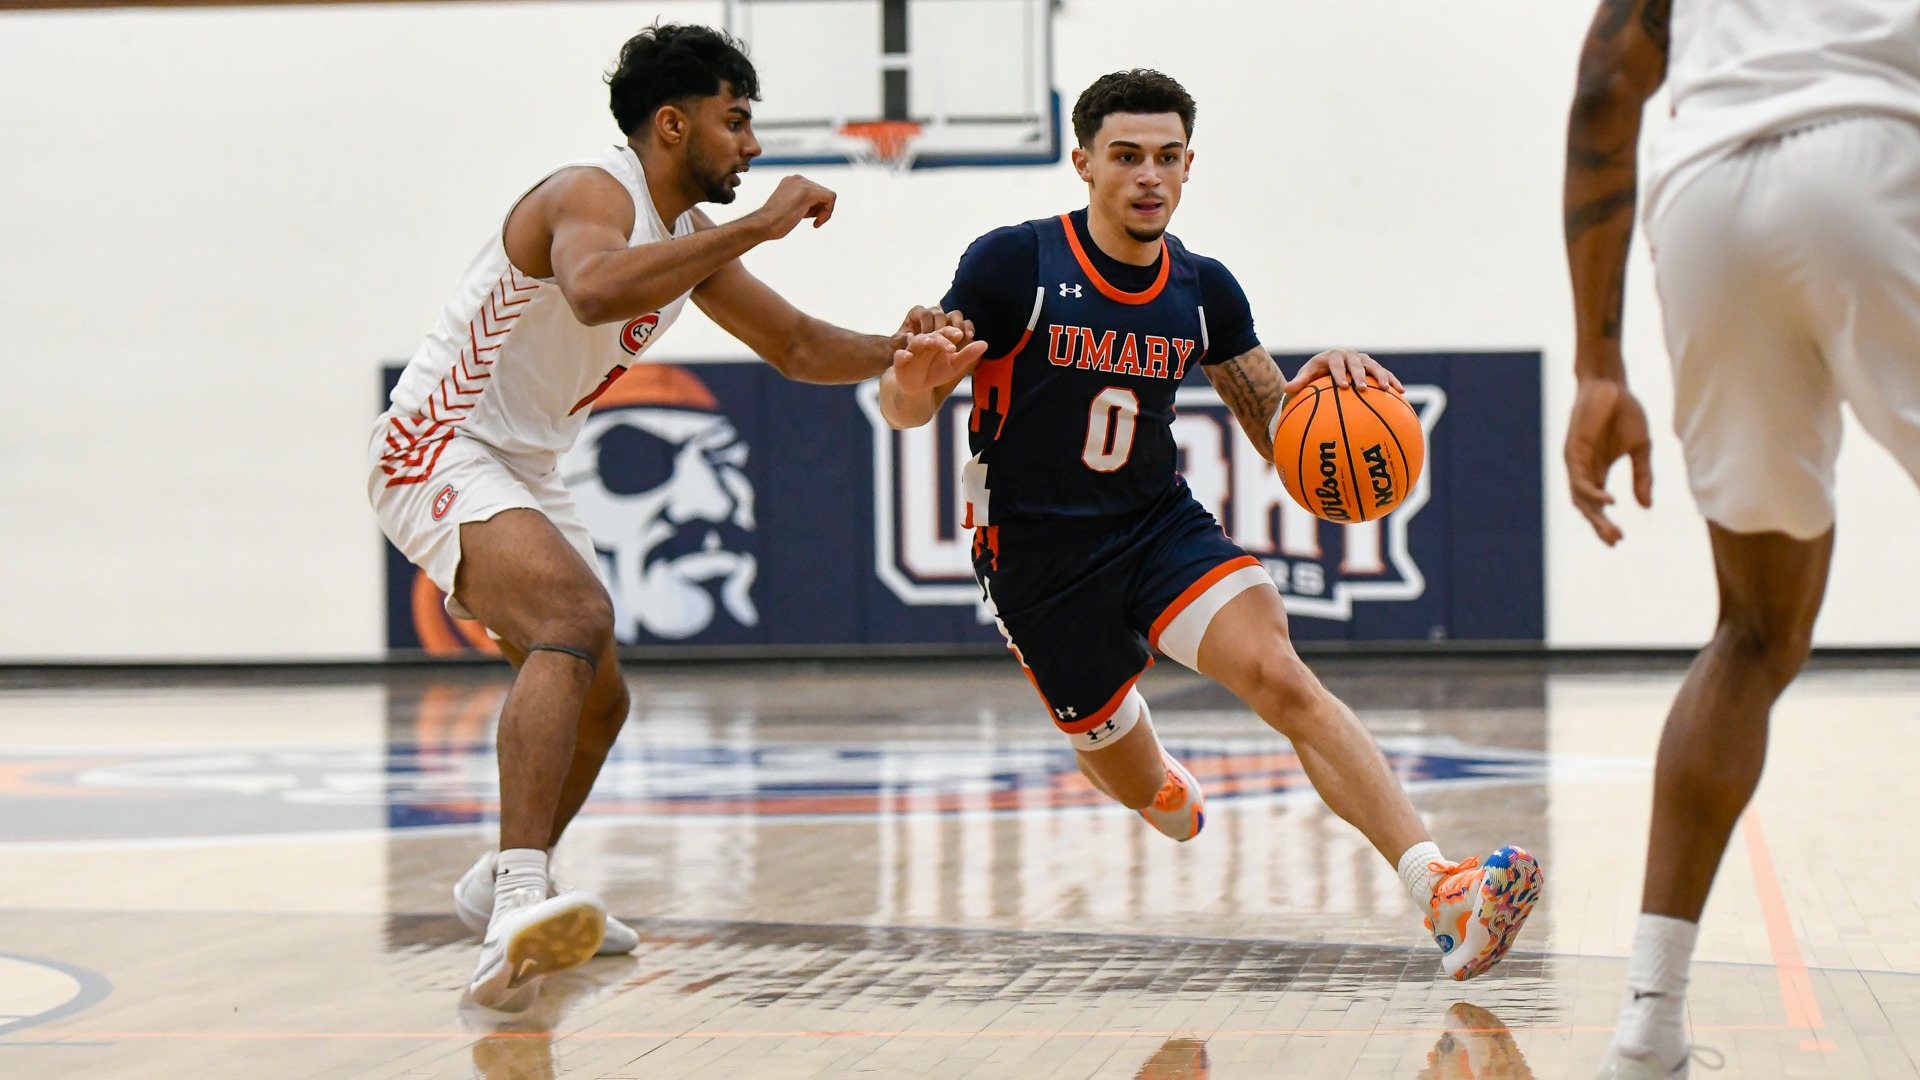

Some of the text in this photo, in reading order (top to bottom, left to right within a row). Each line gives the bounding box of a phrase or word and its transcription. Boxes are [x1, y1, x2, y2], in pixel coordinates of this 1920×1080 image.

[1048, 324, 1195, 379] UMARY
[1081, 386, 1140, 473] 0
[1315, 441, 1351, 520] Wilson
[1362, 443, 1394, 507] NCAA
